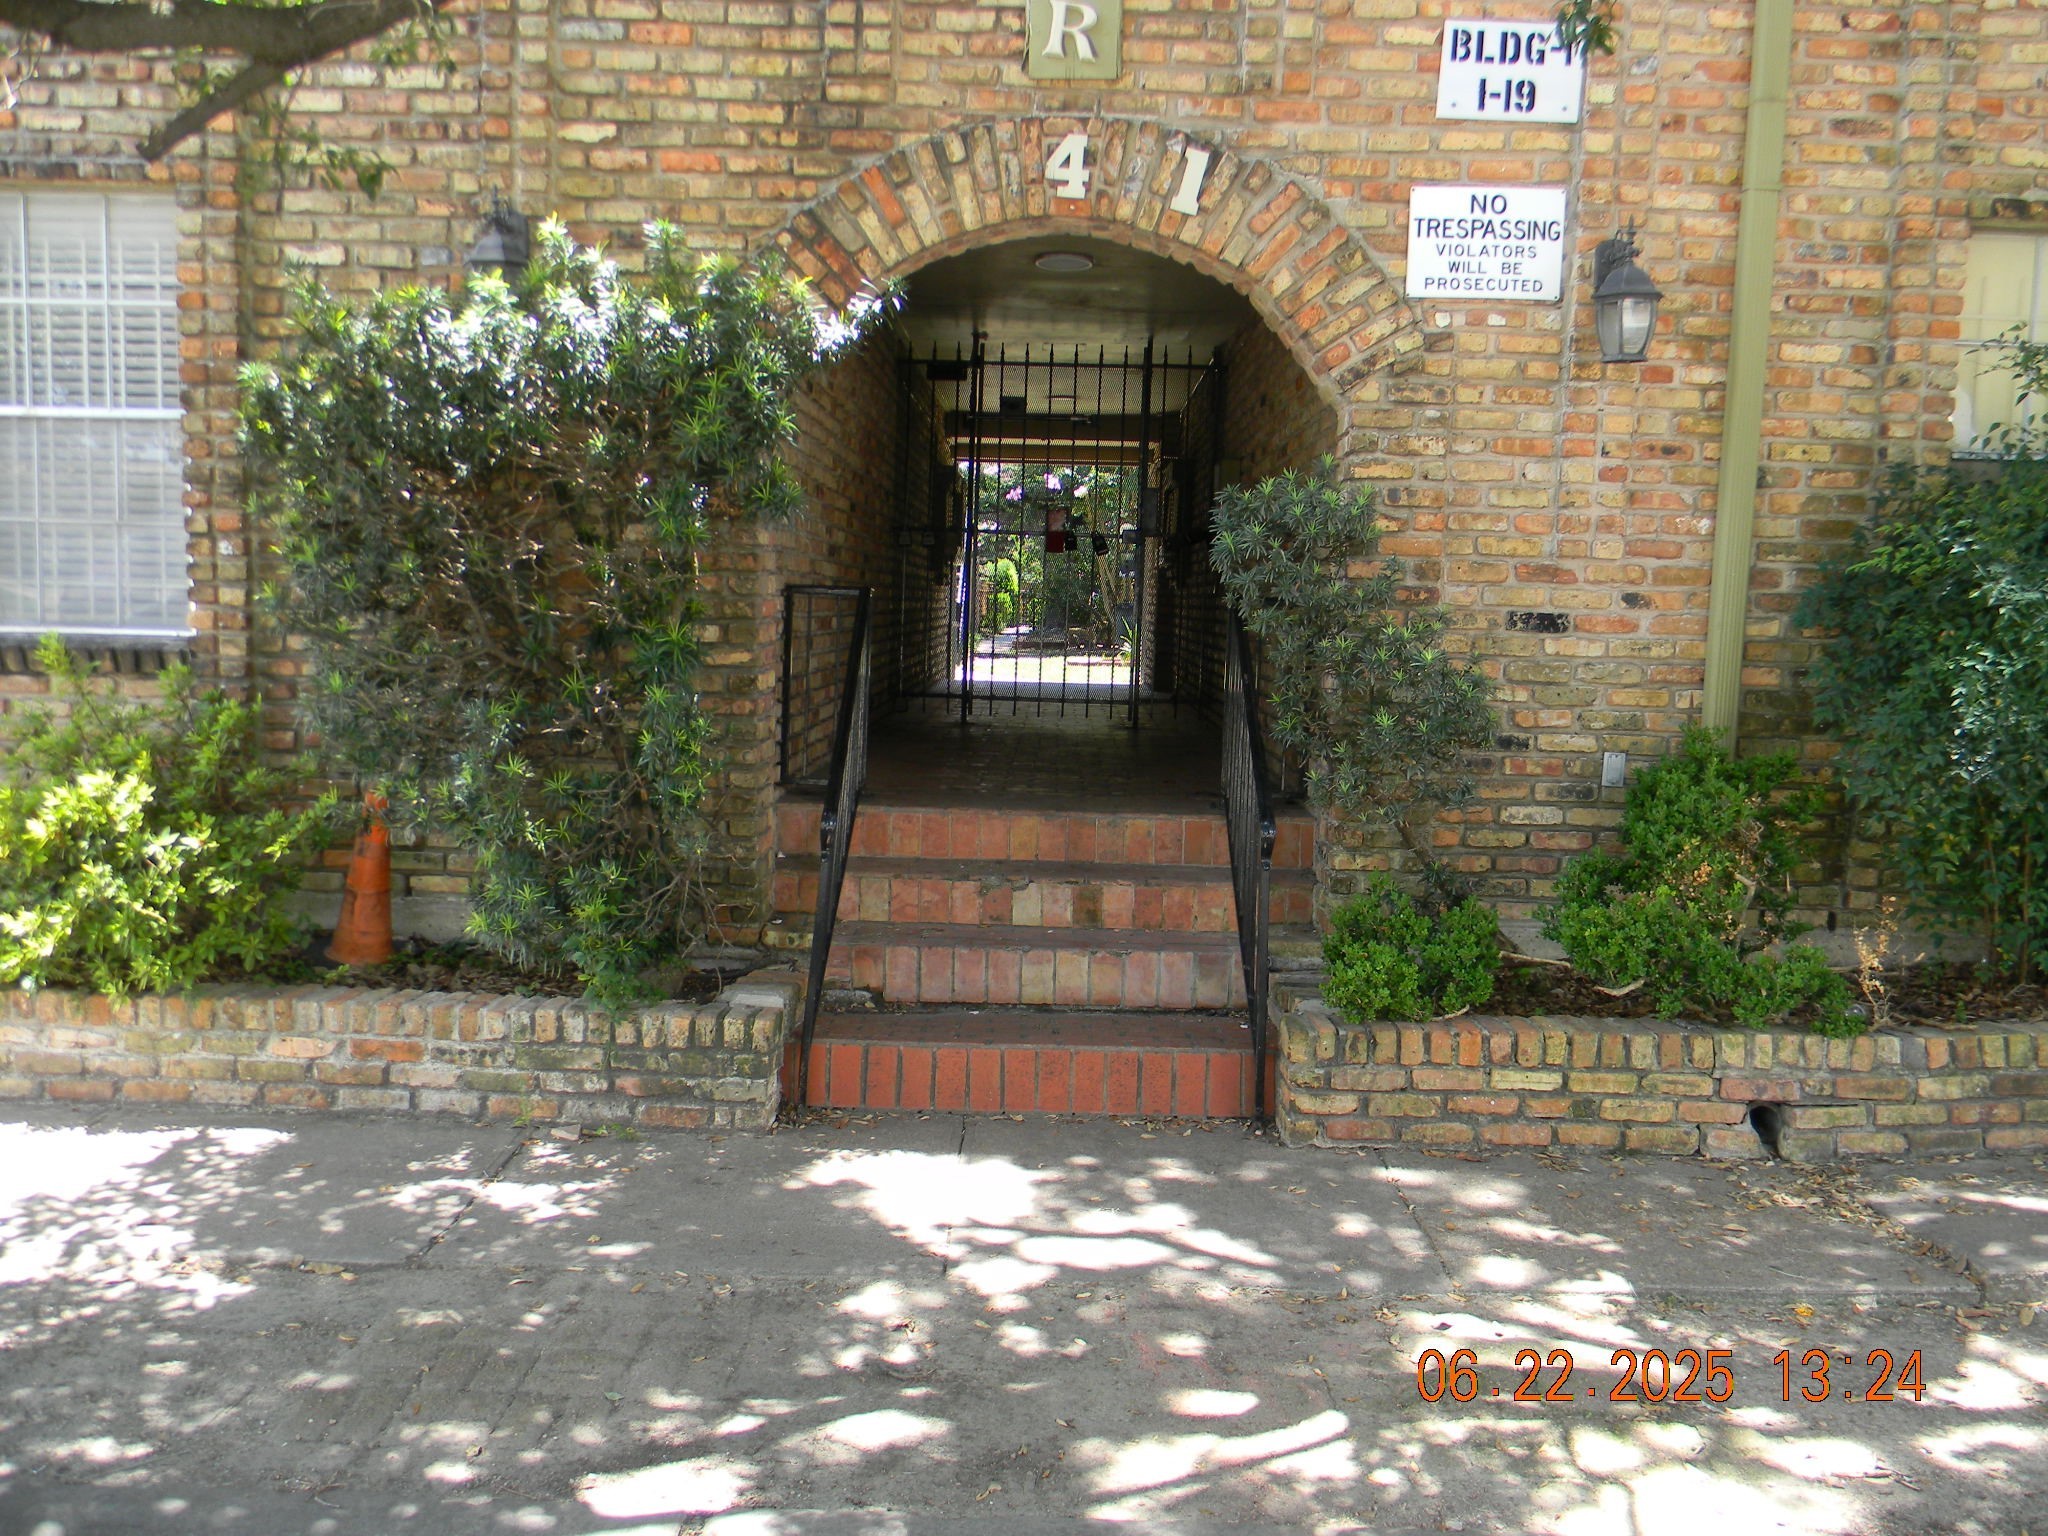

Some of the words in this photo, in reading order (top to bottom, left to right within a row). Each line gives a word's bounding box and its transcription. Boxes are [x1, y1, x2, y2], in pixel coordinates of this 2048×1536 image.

[1042, 0, 1100, 63] R
[1477, 77, 1537, 113] 1-19
[1469, 194, 1507, 215] NO
[1414, 217, 1561, 241] TRESPASSING
[1436, 243, 1537, 259] VIOLATORS
[1448, 260, 1487, 275] WILL
[1501, 262, 1523, 275] BE
[1424, 277, 1543, 293] PROSECUTED
